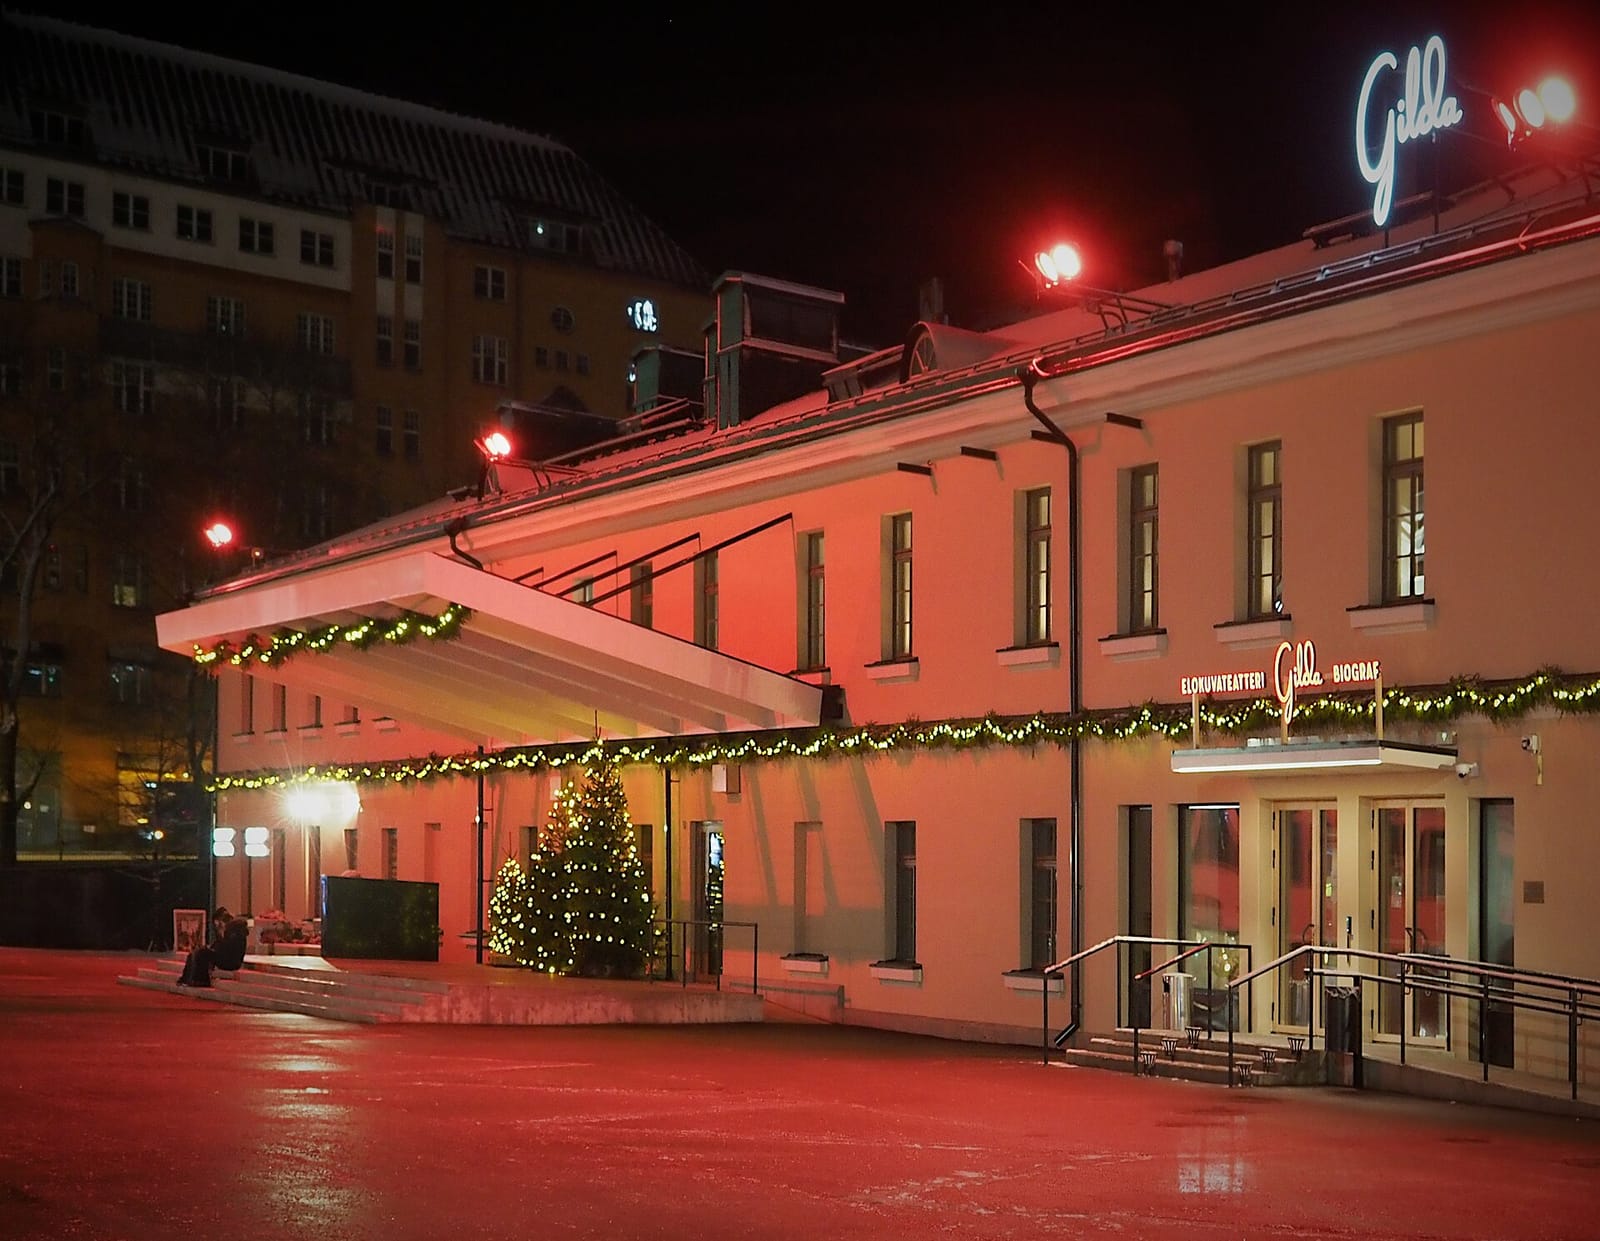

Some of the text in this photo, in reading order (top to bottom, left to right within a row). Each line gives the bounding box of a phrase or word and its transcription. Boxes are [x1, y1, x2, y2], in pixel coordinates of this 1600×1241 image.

[1356, 35, 1463, 226] Gilda
[1181, 640, 1380, 725] ELOKUVATEATTERI Gilda BIOGRAF
